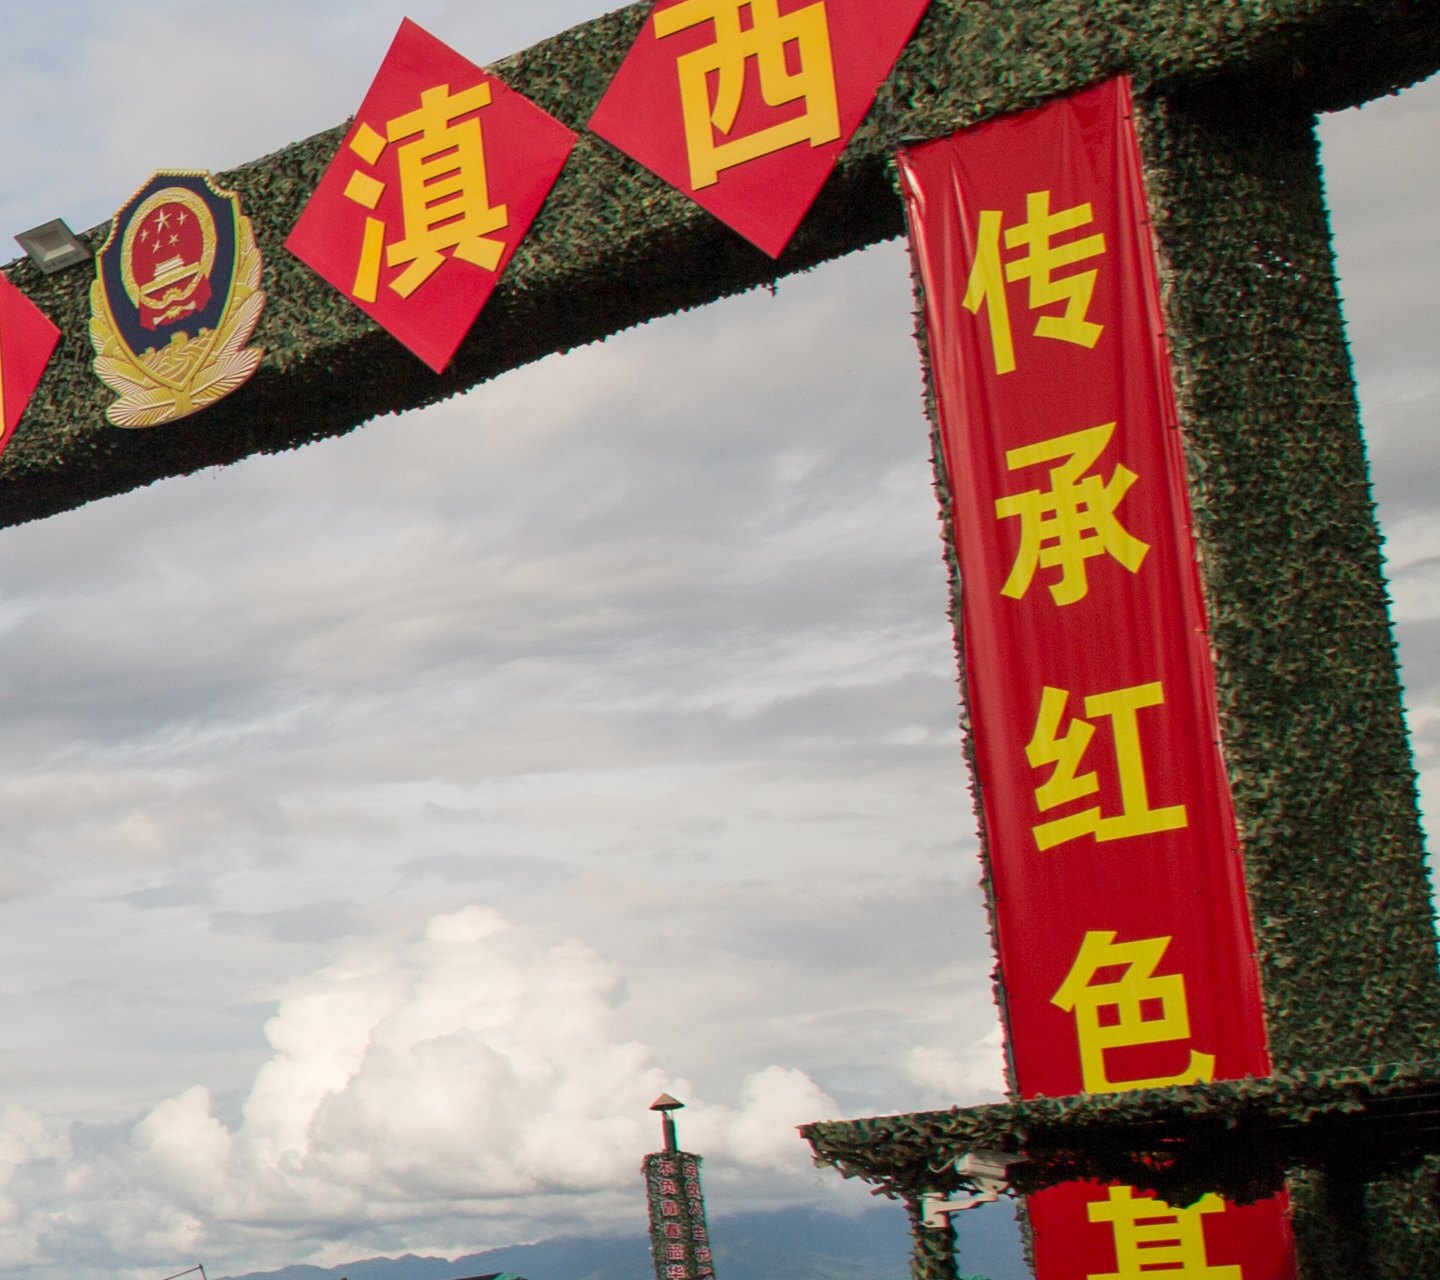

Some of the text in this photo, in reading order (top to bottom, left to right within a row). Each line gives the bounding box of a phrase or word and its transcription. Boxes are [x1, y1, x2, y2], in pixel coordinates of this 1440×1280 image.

[657, 1160, 686, 1280] 不负青春韶华
